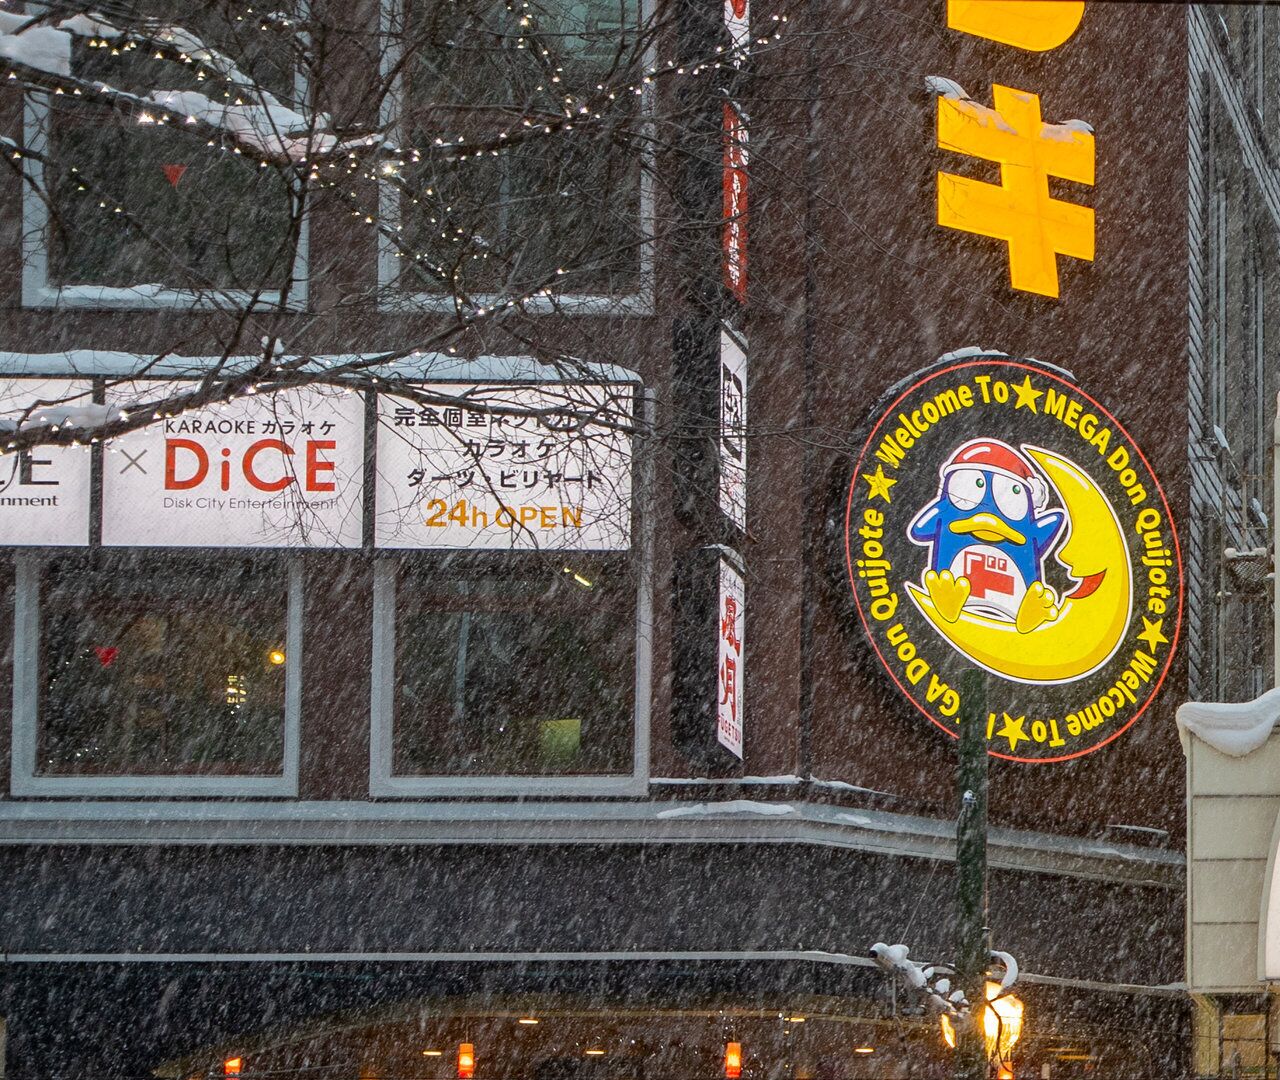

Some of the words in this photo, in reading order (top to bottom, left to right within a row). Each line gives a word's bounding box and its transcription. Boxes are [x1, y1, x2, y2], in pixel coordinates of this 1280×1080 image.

[165, 420, 256, 435] KARAOKE
[262, 421, 336, 436] カラオケ
[462, 438, 559, 459] カラオケ
[875, 385, 975, 470] Welcome
[974, 375, 1010, 405] To
[164, 438, 337, 492] DiCE
[163, 497, 192, 509] Disk
[196, 497, 226, 511] City
[1044, 388, 1112, 456] MEGA
[1106, 445, 1149, 507] Don
[1135, 507, 1172, 616] Quijote
[858, 508, 899, 623] Quijote
[886, 623, 931, 686] Don
[1067, 650, 1158, 738] Welcome
[1032, 718, 1067, 748] To
